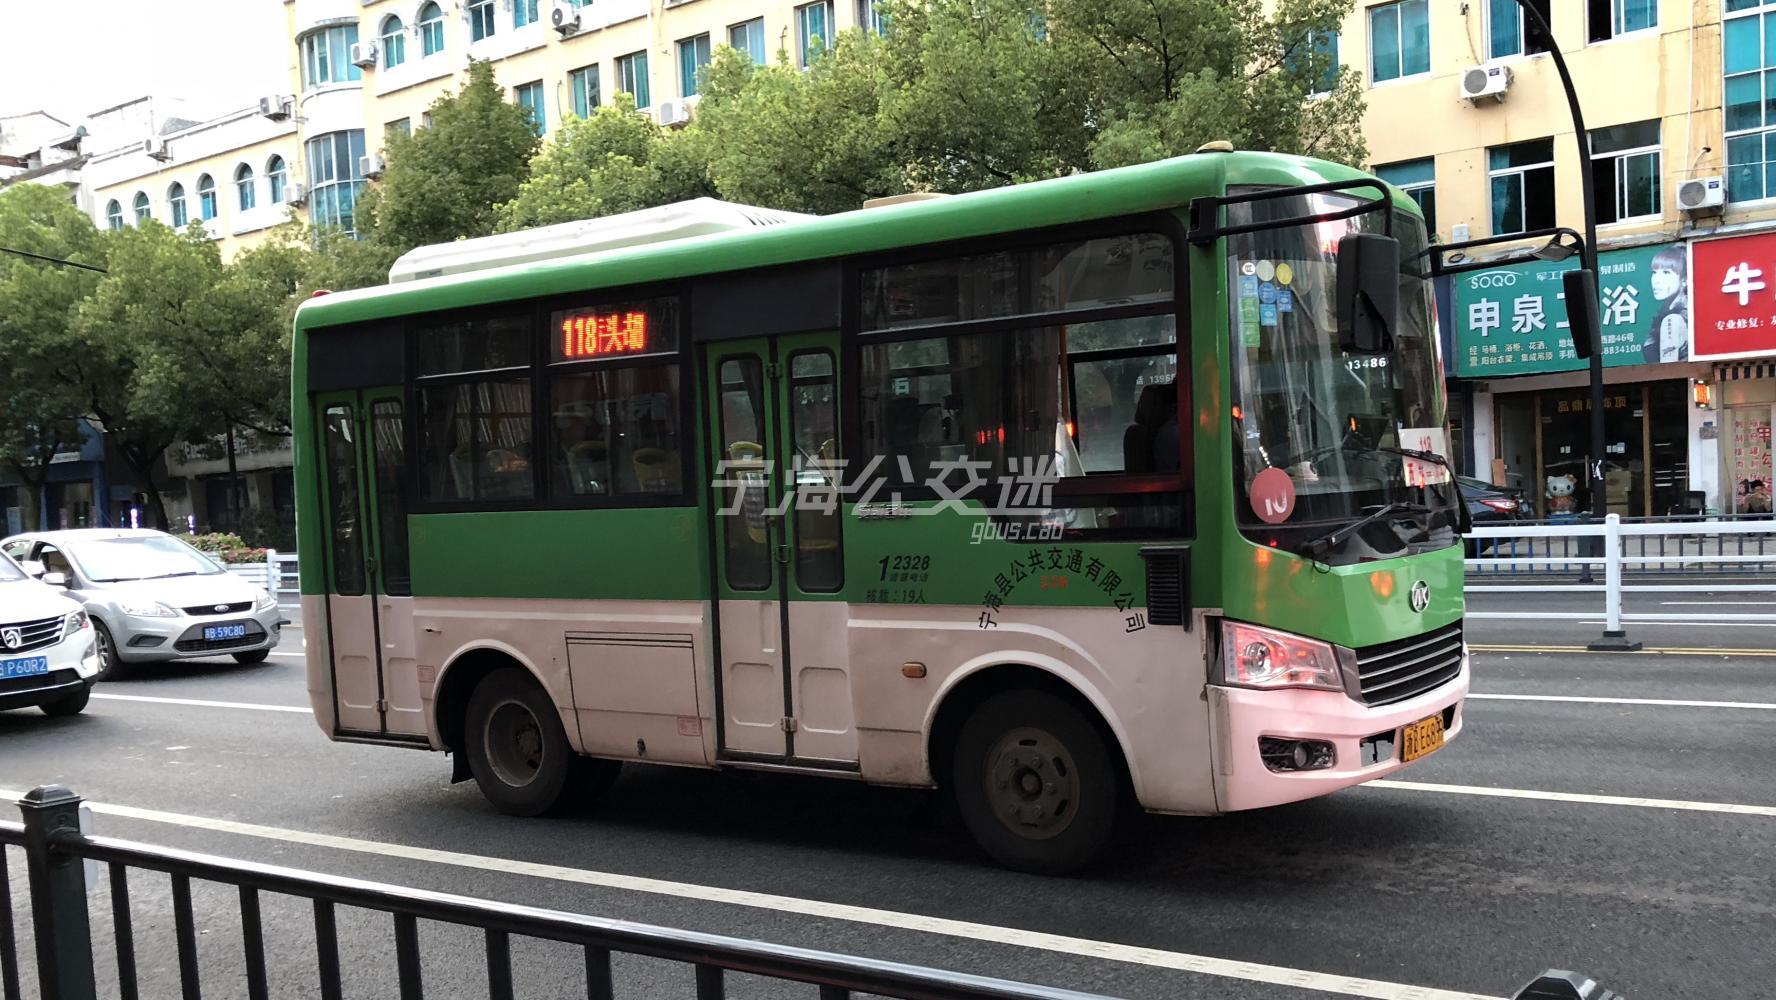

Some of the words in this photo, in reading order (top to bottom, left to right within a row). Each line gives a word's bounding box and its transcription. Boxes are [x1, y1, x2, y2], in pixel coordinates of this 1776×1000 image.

[1470, 273, 1517, 289] SOQO
[1721, 262, 1776, 306] 牛
[979, 546, 1146, 633] 宁海县公共交通有限公司
